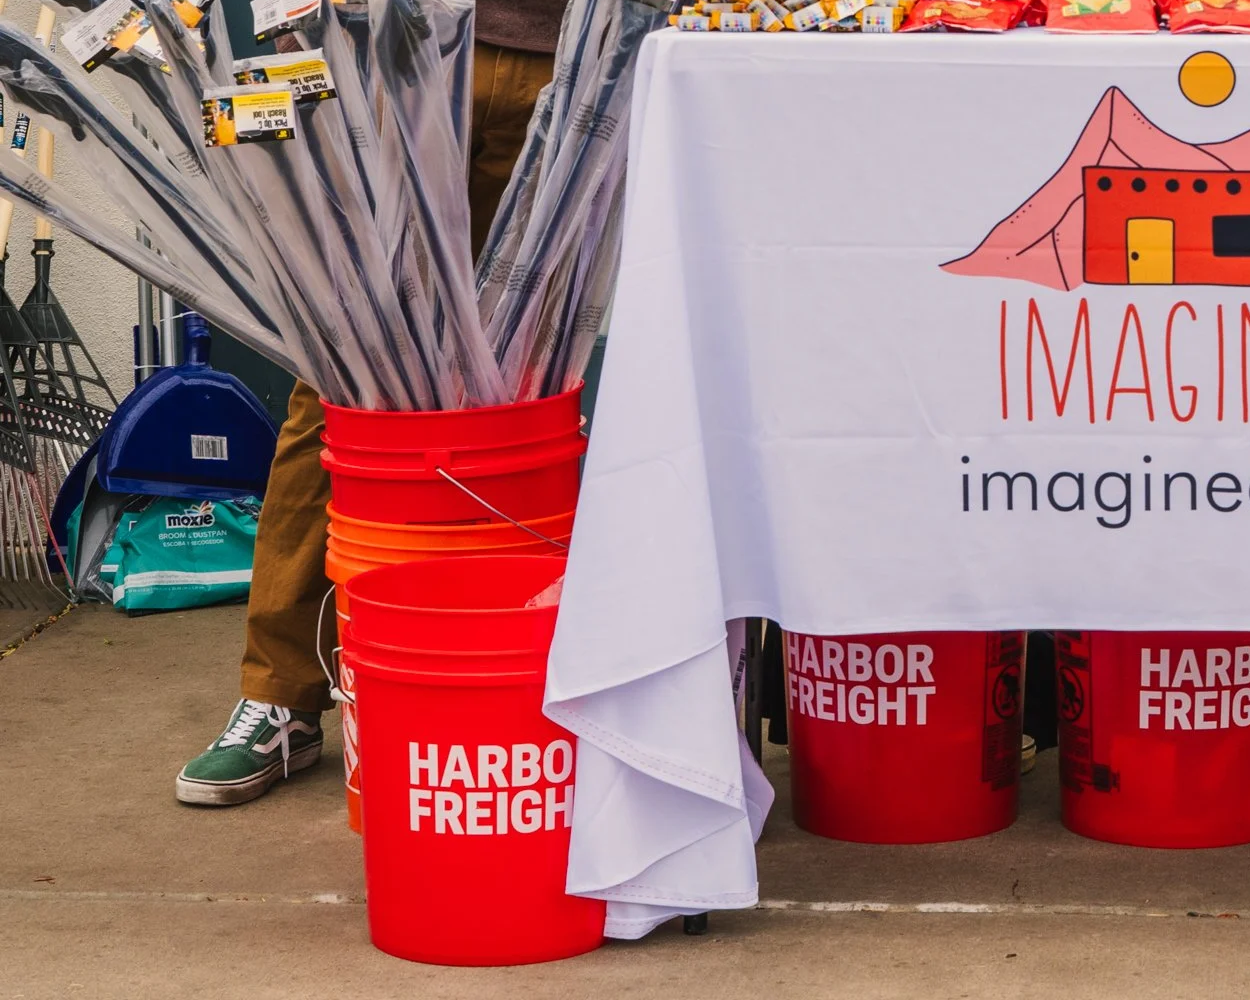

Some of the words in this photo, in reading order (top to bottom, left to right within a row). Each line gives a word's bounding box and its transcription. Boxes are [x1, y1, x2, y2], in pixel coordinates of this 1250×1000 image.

[303, 72, 325, 84] Reach
[302, 83, 312, 92] Up
[311, 82, 328, 91] Pick
[252, 110, 266, 120] Tool
[267, 108, 287, 119] Reach
[263, 119, 273, 128] Up
[274, 118, 288, 128] Pick
[167, 513, 214, 527] moxie
[193, 530, 228, 539] DUSTPAN
[787, 632, 935, 684] HARBOR
[788, 677, 936, 727] FREIGHT
[408, 739, 573, 789] HARBO
[408, 784, 575, 836] FREIGH
